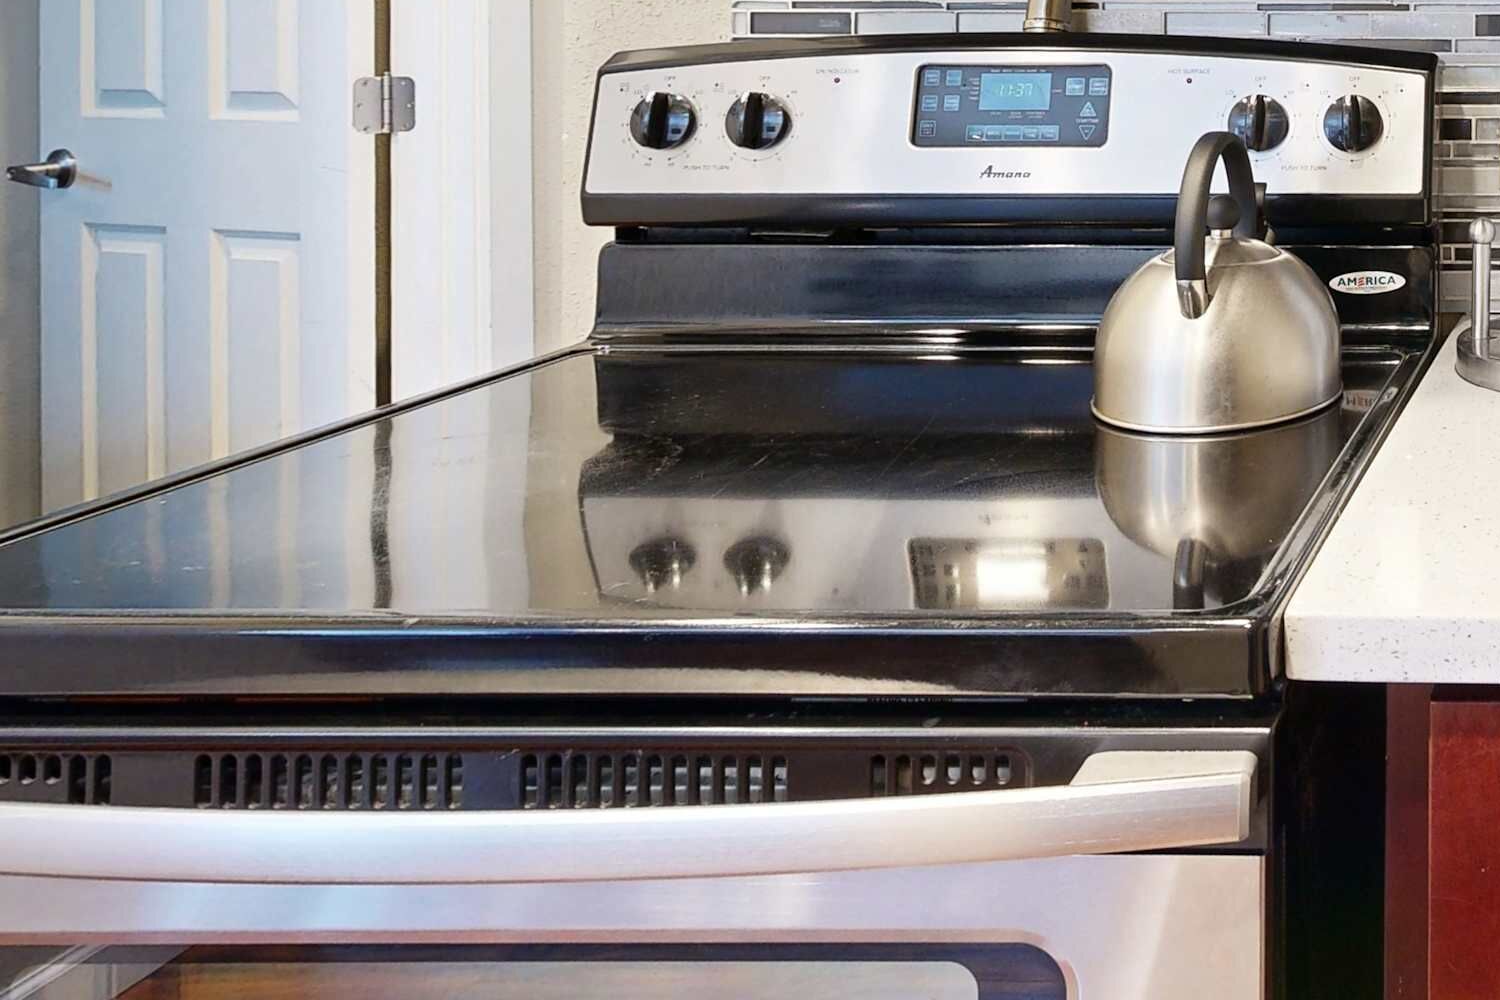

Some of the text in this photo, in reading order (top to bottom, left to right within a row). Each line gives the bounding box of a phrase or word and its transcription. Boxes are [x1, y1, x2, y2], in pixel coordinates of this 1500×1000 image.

[998, 83, 1033, 97] 11:37
[980, 165, 1031, 178] Amana
[1338, 276, 1396, 288] AMERICA
